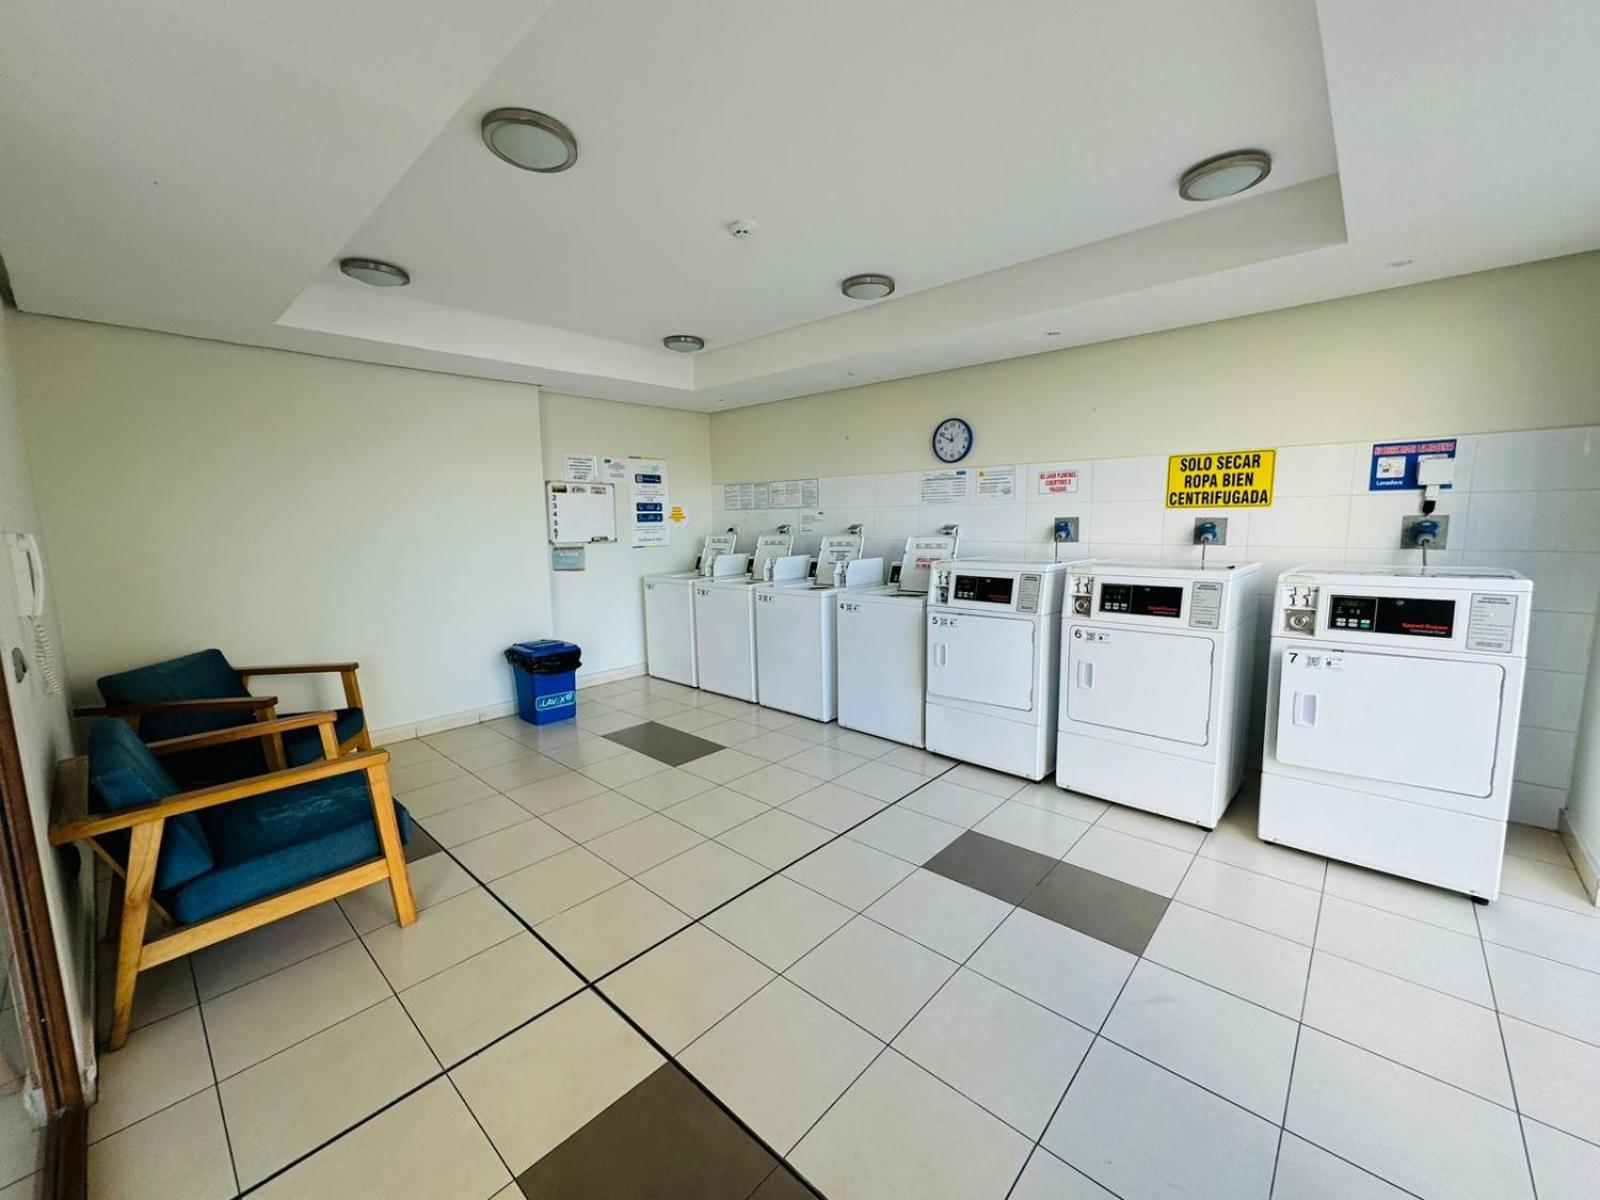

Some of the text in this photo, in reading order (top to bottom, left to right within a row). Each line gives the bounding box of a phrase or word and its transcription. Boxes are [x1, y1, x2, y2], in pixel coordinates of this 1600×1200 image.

[1180, 454, 1261, 472] SOLO SECAR
[1184, 472, 1254, 488] ROPA BIEN
[1169, 489, 1268, 506] CENTRIFUGADA
[931, 616, 938, 625] 5
[1074, 629, 1082, 639] 6
[1288, 652, 1298, 664] 7
